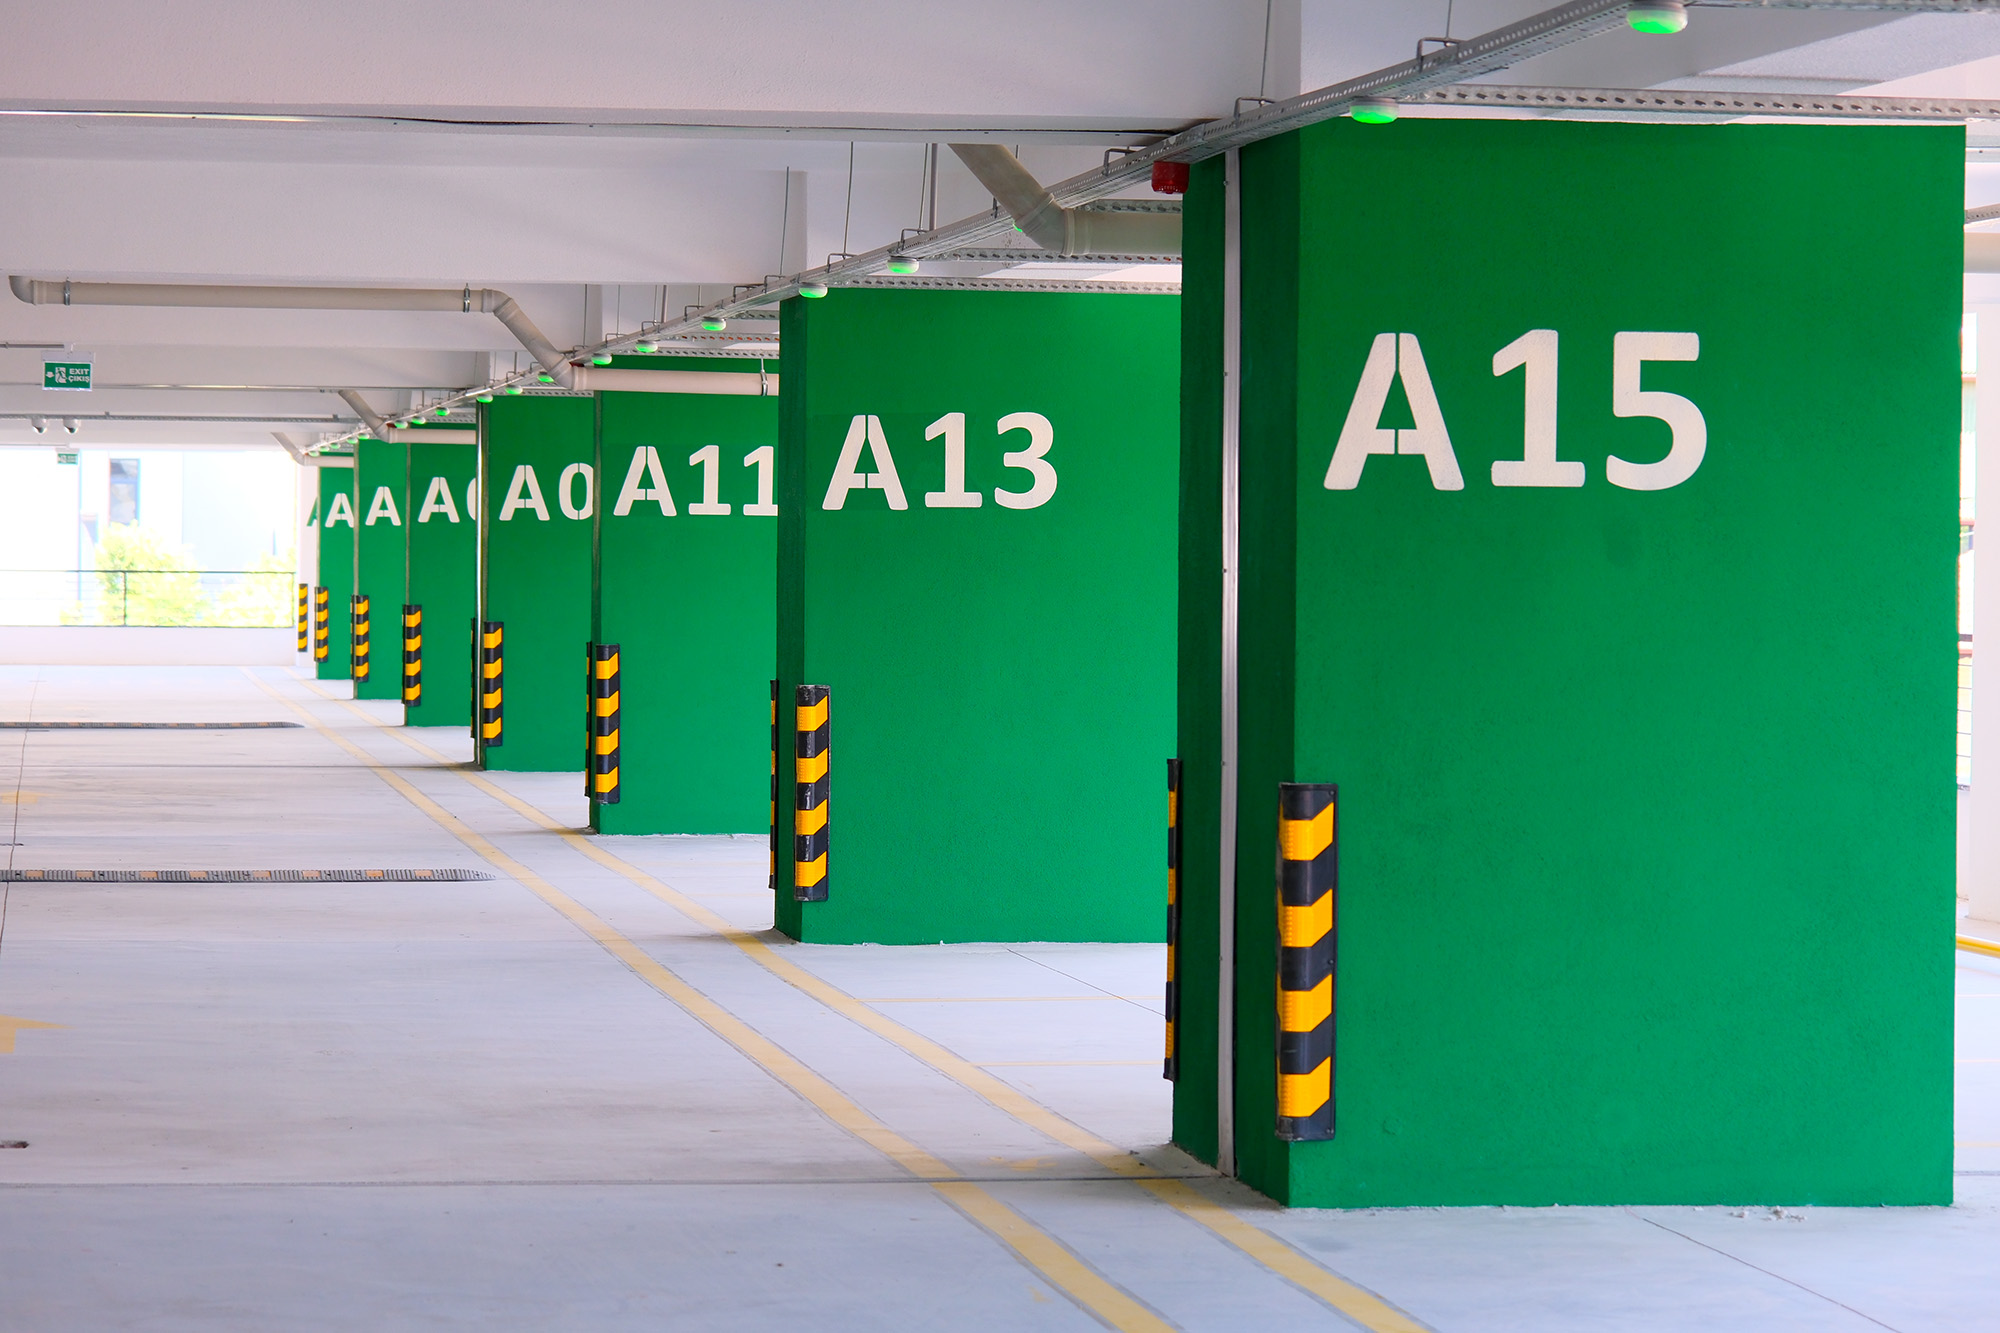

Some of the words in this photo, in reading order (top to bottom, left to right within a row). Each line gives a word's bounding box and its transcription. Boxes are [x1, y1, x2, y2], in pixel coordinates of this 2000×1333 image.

[1323, 329, 1708, 492] A15
[613, 445, 779, 517] A11
[822, 411, 1058, 512] A13
[324, 493, 355, 528] A
[365, 486, 402, 526] A
